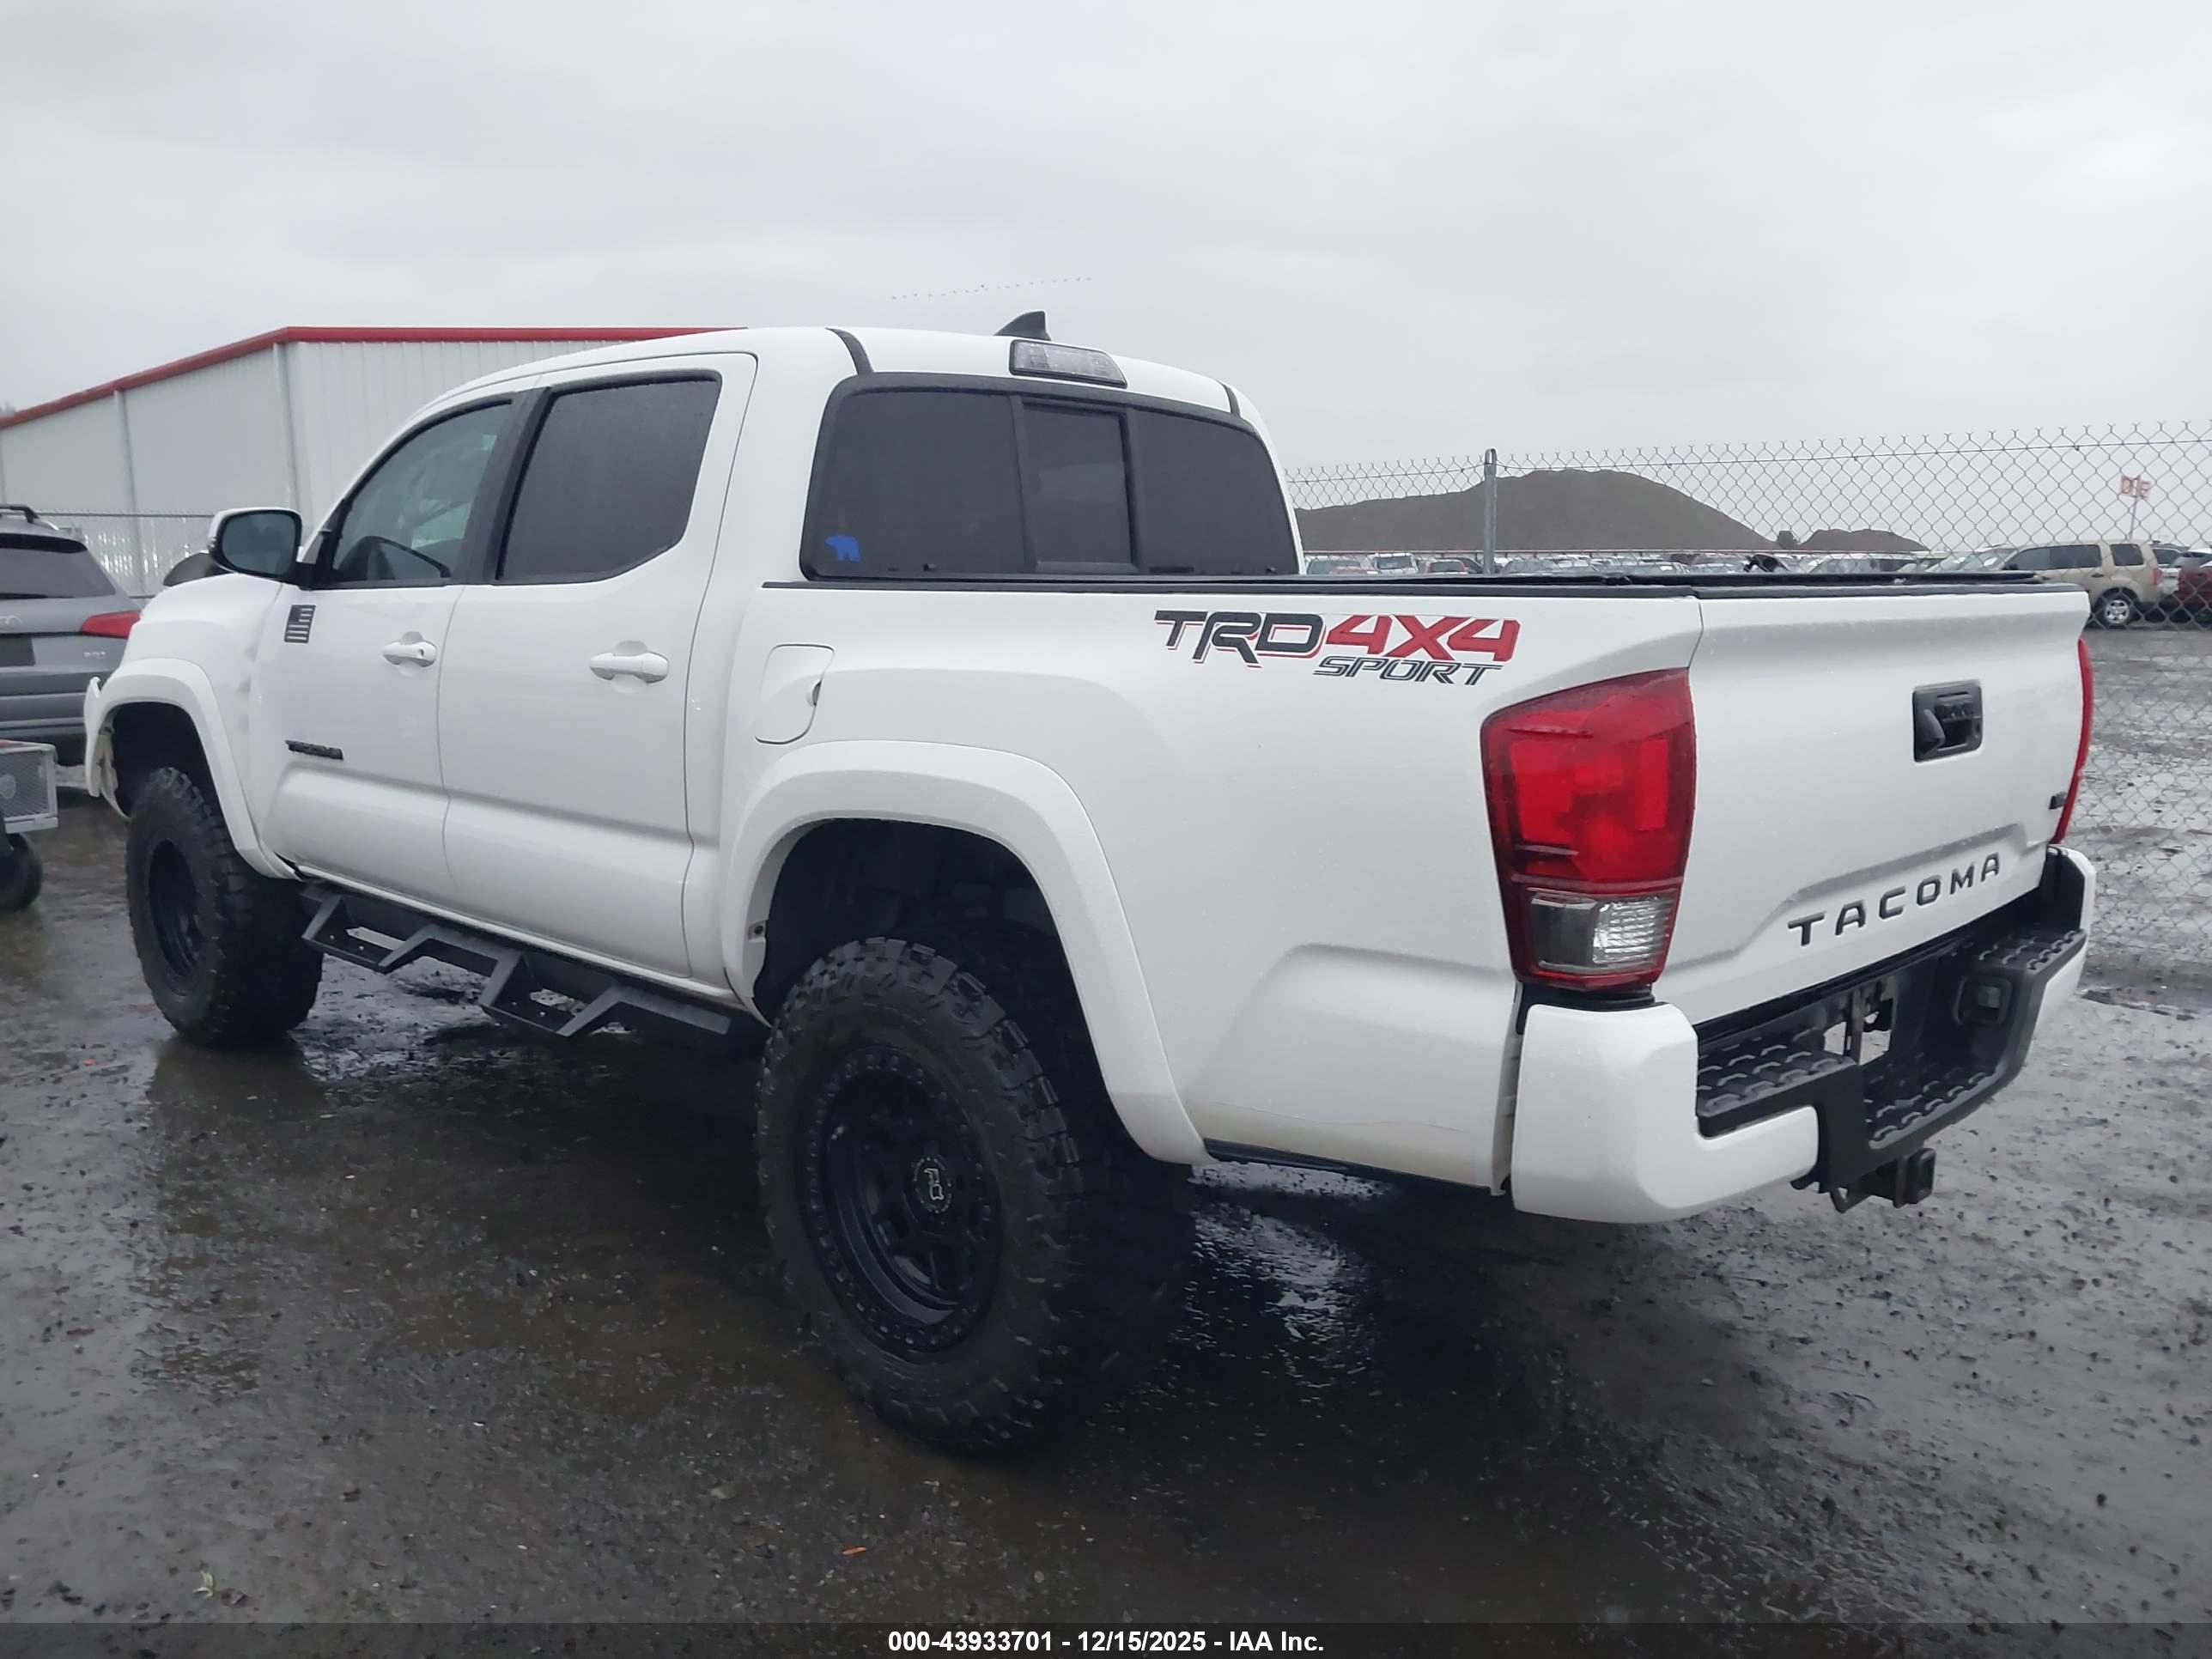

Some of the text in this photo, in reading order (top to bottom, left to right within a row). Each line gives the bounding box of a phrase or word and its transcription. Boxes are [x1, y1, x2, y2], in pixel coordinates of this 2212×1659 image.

[1153, 611, 1328, 668] TRD
[1313, 656, 1503, 685] SPORT
[1788, 852, 2001, 946] TACOMA
